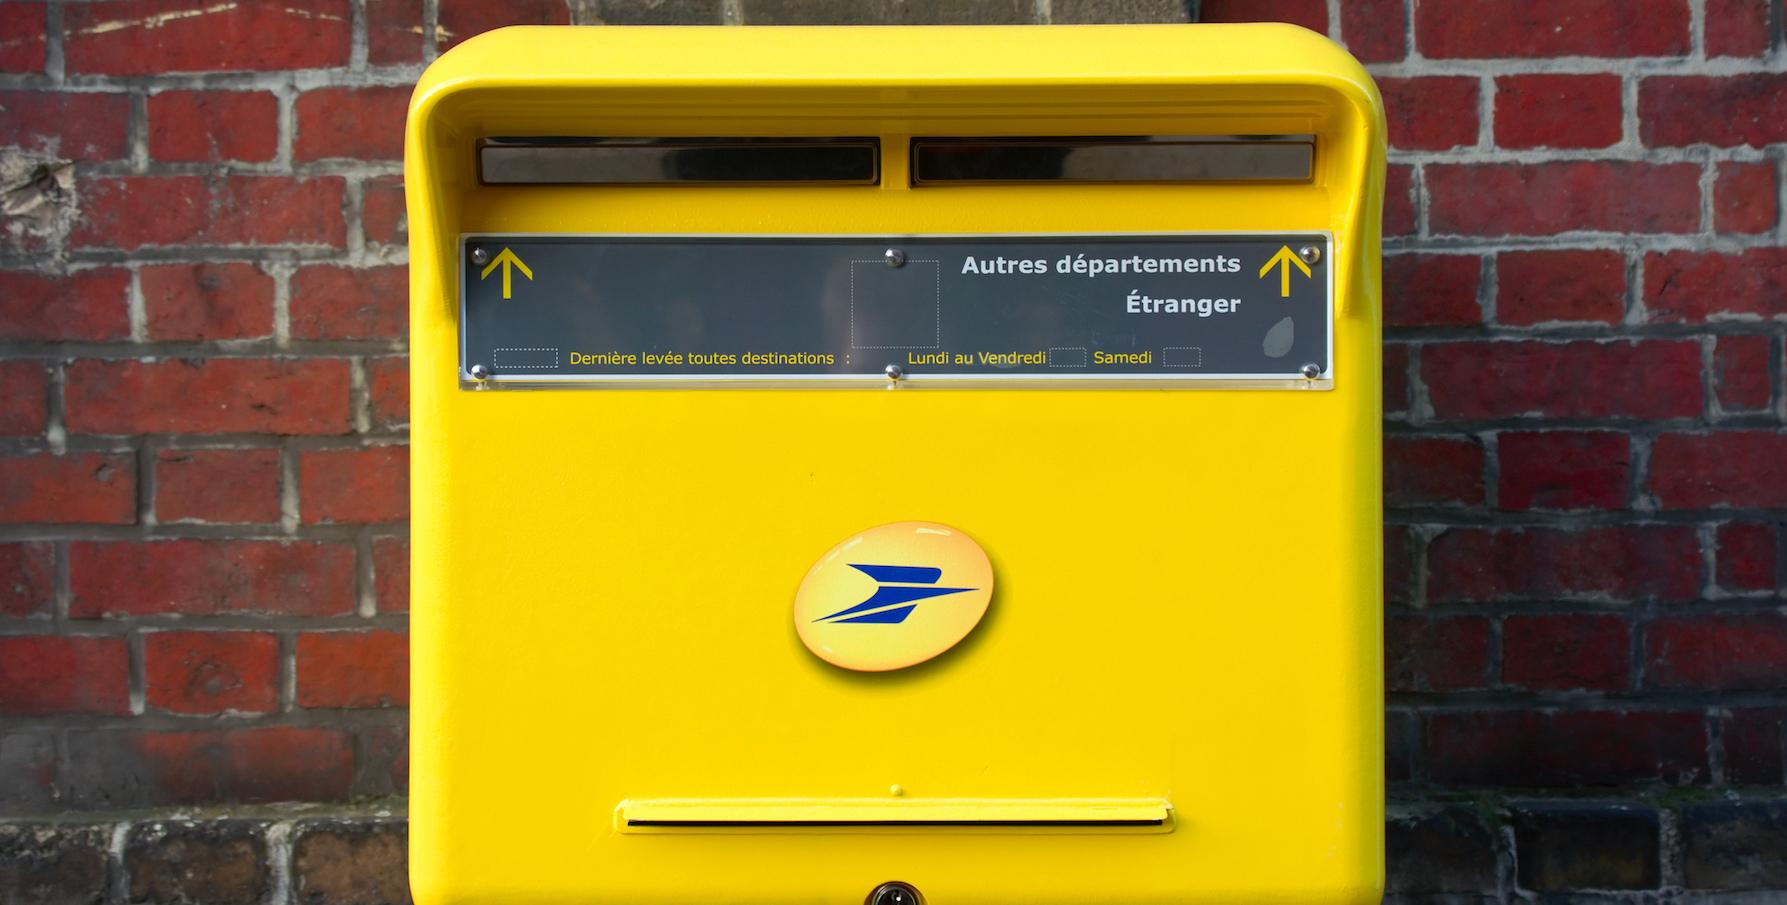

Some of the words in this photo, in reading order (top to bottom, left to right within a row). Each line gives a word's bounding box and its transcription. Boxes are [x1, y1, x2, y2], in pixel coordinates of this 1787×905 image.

[961, 256, 1048, 275] Autres
[1055, 253, 1241, 278] départements
[1126, 289, 1242, 317] Étranger
[569, 350, 637, 365] Dernière
[642, 350, 684, 365] levée
[687, 352, 737, 365] toutes
[741, 351, 835, 365] destinations
[907, 350, 949, 365] Lundi
[954, 353, 974, 365] au
[977, 351, 1046, 365] Vendredi
[1093, 350, 1152, 365] Samedi
